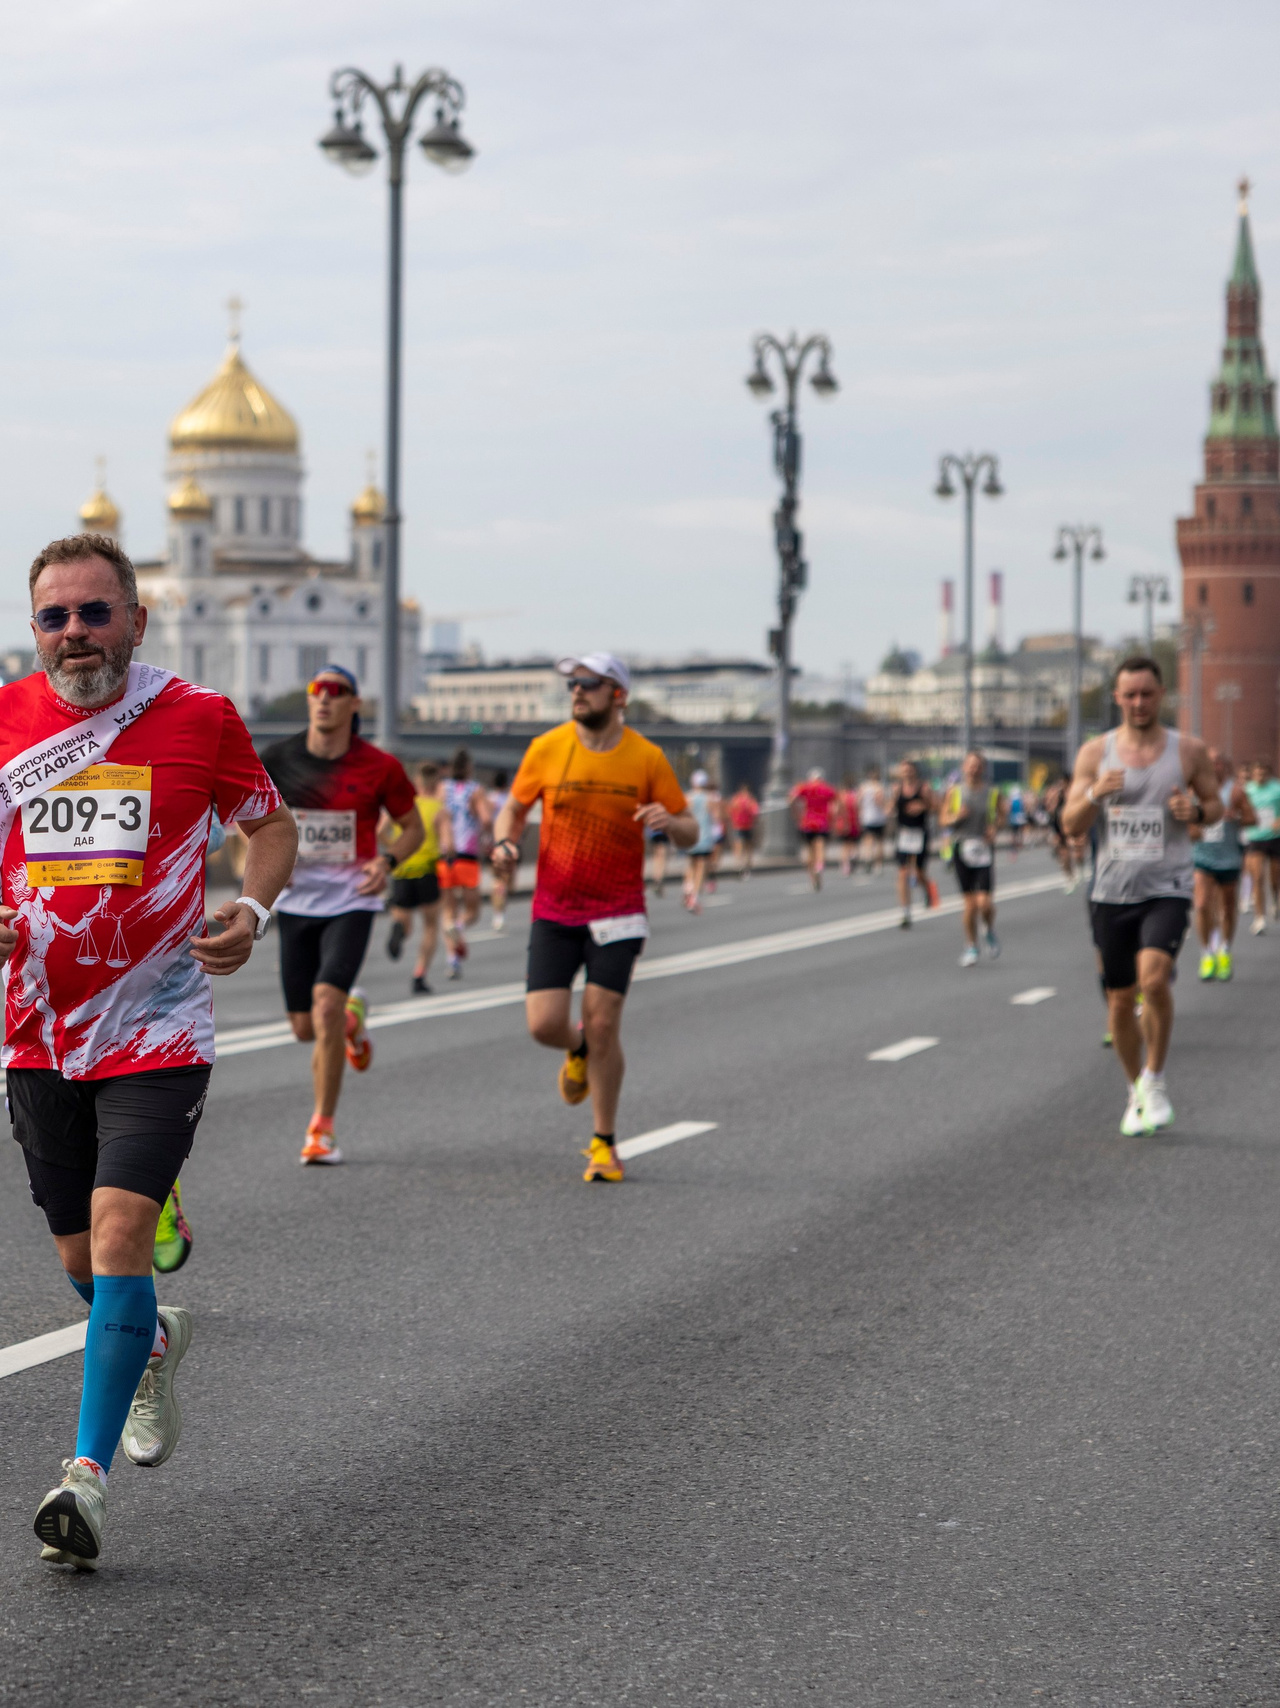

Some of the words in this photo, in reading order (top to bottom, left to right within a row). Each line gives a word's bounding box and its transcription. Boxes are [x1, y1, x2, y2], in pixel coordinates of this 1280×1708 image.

[7, 730, 95, 782] КОРПОРАТИВНАЯ
[12, 740, 101, 795] ЭСТАФЕТА
[28, 796, 142, 834] 209-3
[74, 836, 95, 847] ДАВ
[105, 1322, 150, 1338] cep
